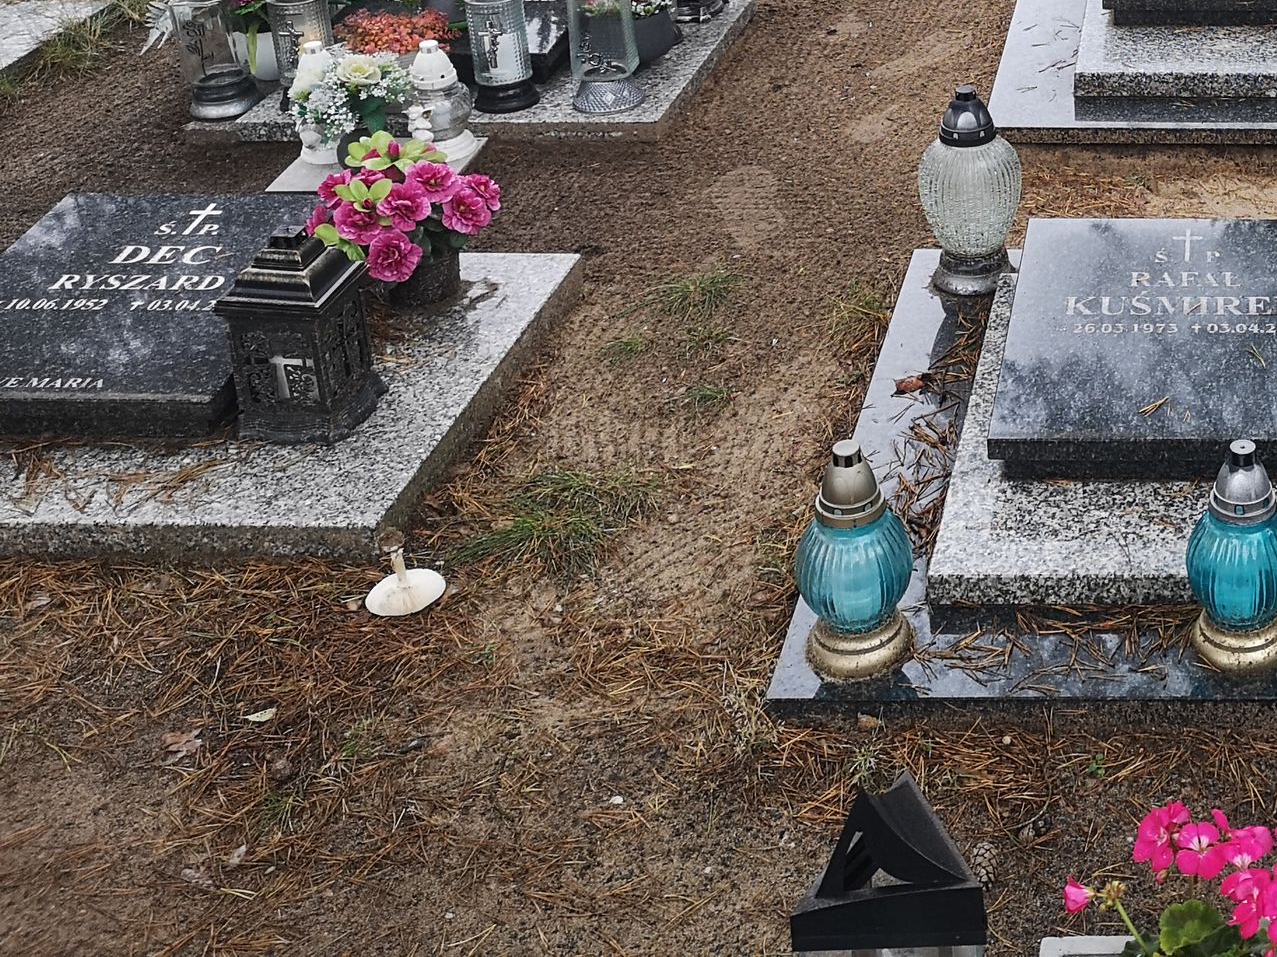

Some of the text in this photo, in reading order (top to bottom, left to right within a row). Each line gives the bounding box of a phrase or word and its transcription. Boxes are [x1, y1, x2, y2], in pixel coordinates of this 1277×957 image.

[108, 245, 223, 265] DEC
[47, 274, 226, 290] RYSZARD
[1129, 271, 1242, 287] RAFAŁ
[4, 298, 217, 311] 10.06.1952 03.04.2
[23, 377, 104, 388] MARIA
